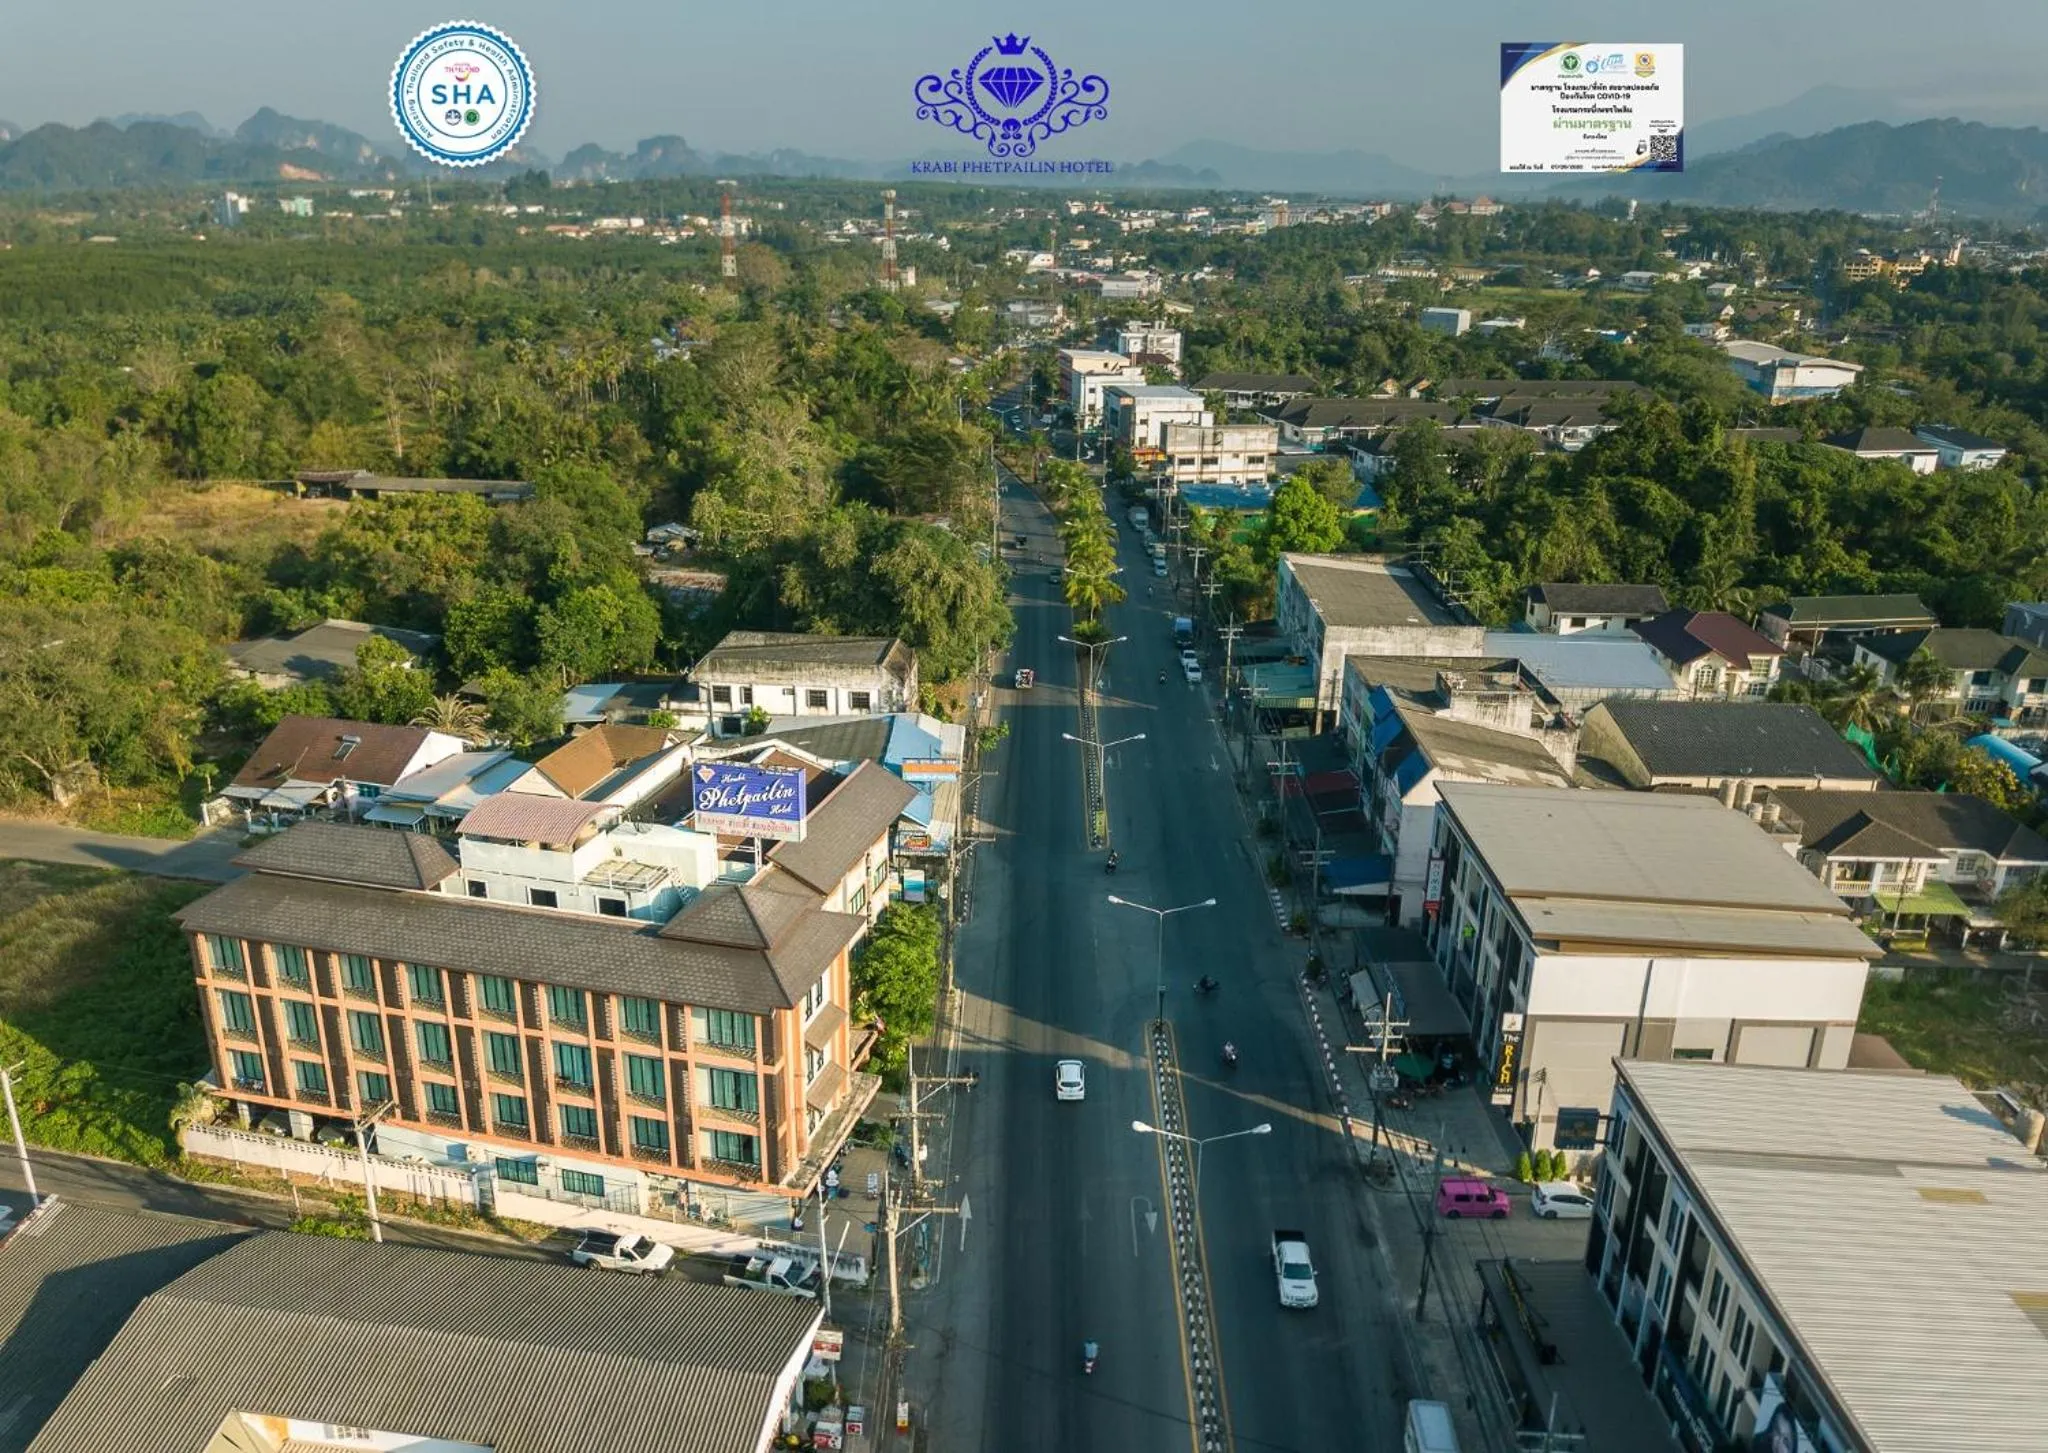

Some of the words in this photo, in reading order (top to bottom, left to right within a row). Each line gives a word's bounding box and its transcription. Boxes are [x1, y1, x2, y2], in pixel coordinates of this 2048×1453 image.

[699, 778, 795, 815] Phetpailin
[1503, 1034, 1520, 1043] The
[1500, 1044, 1514, 1084] RICH
